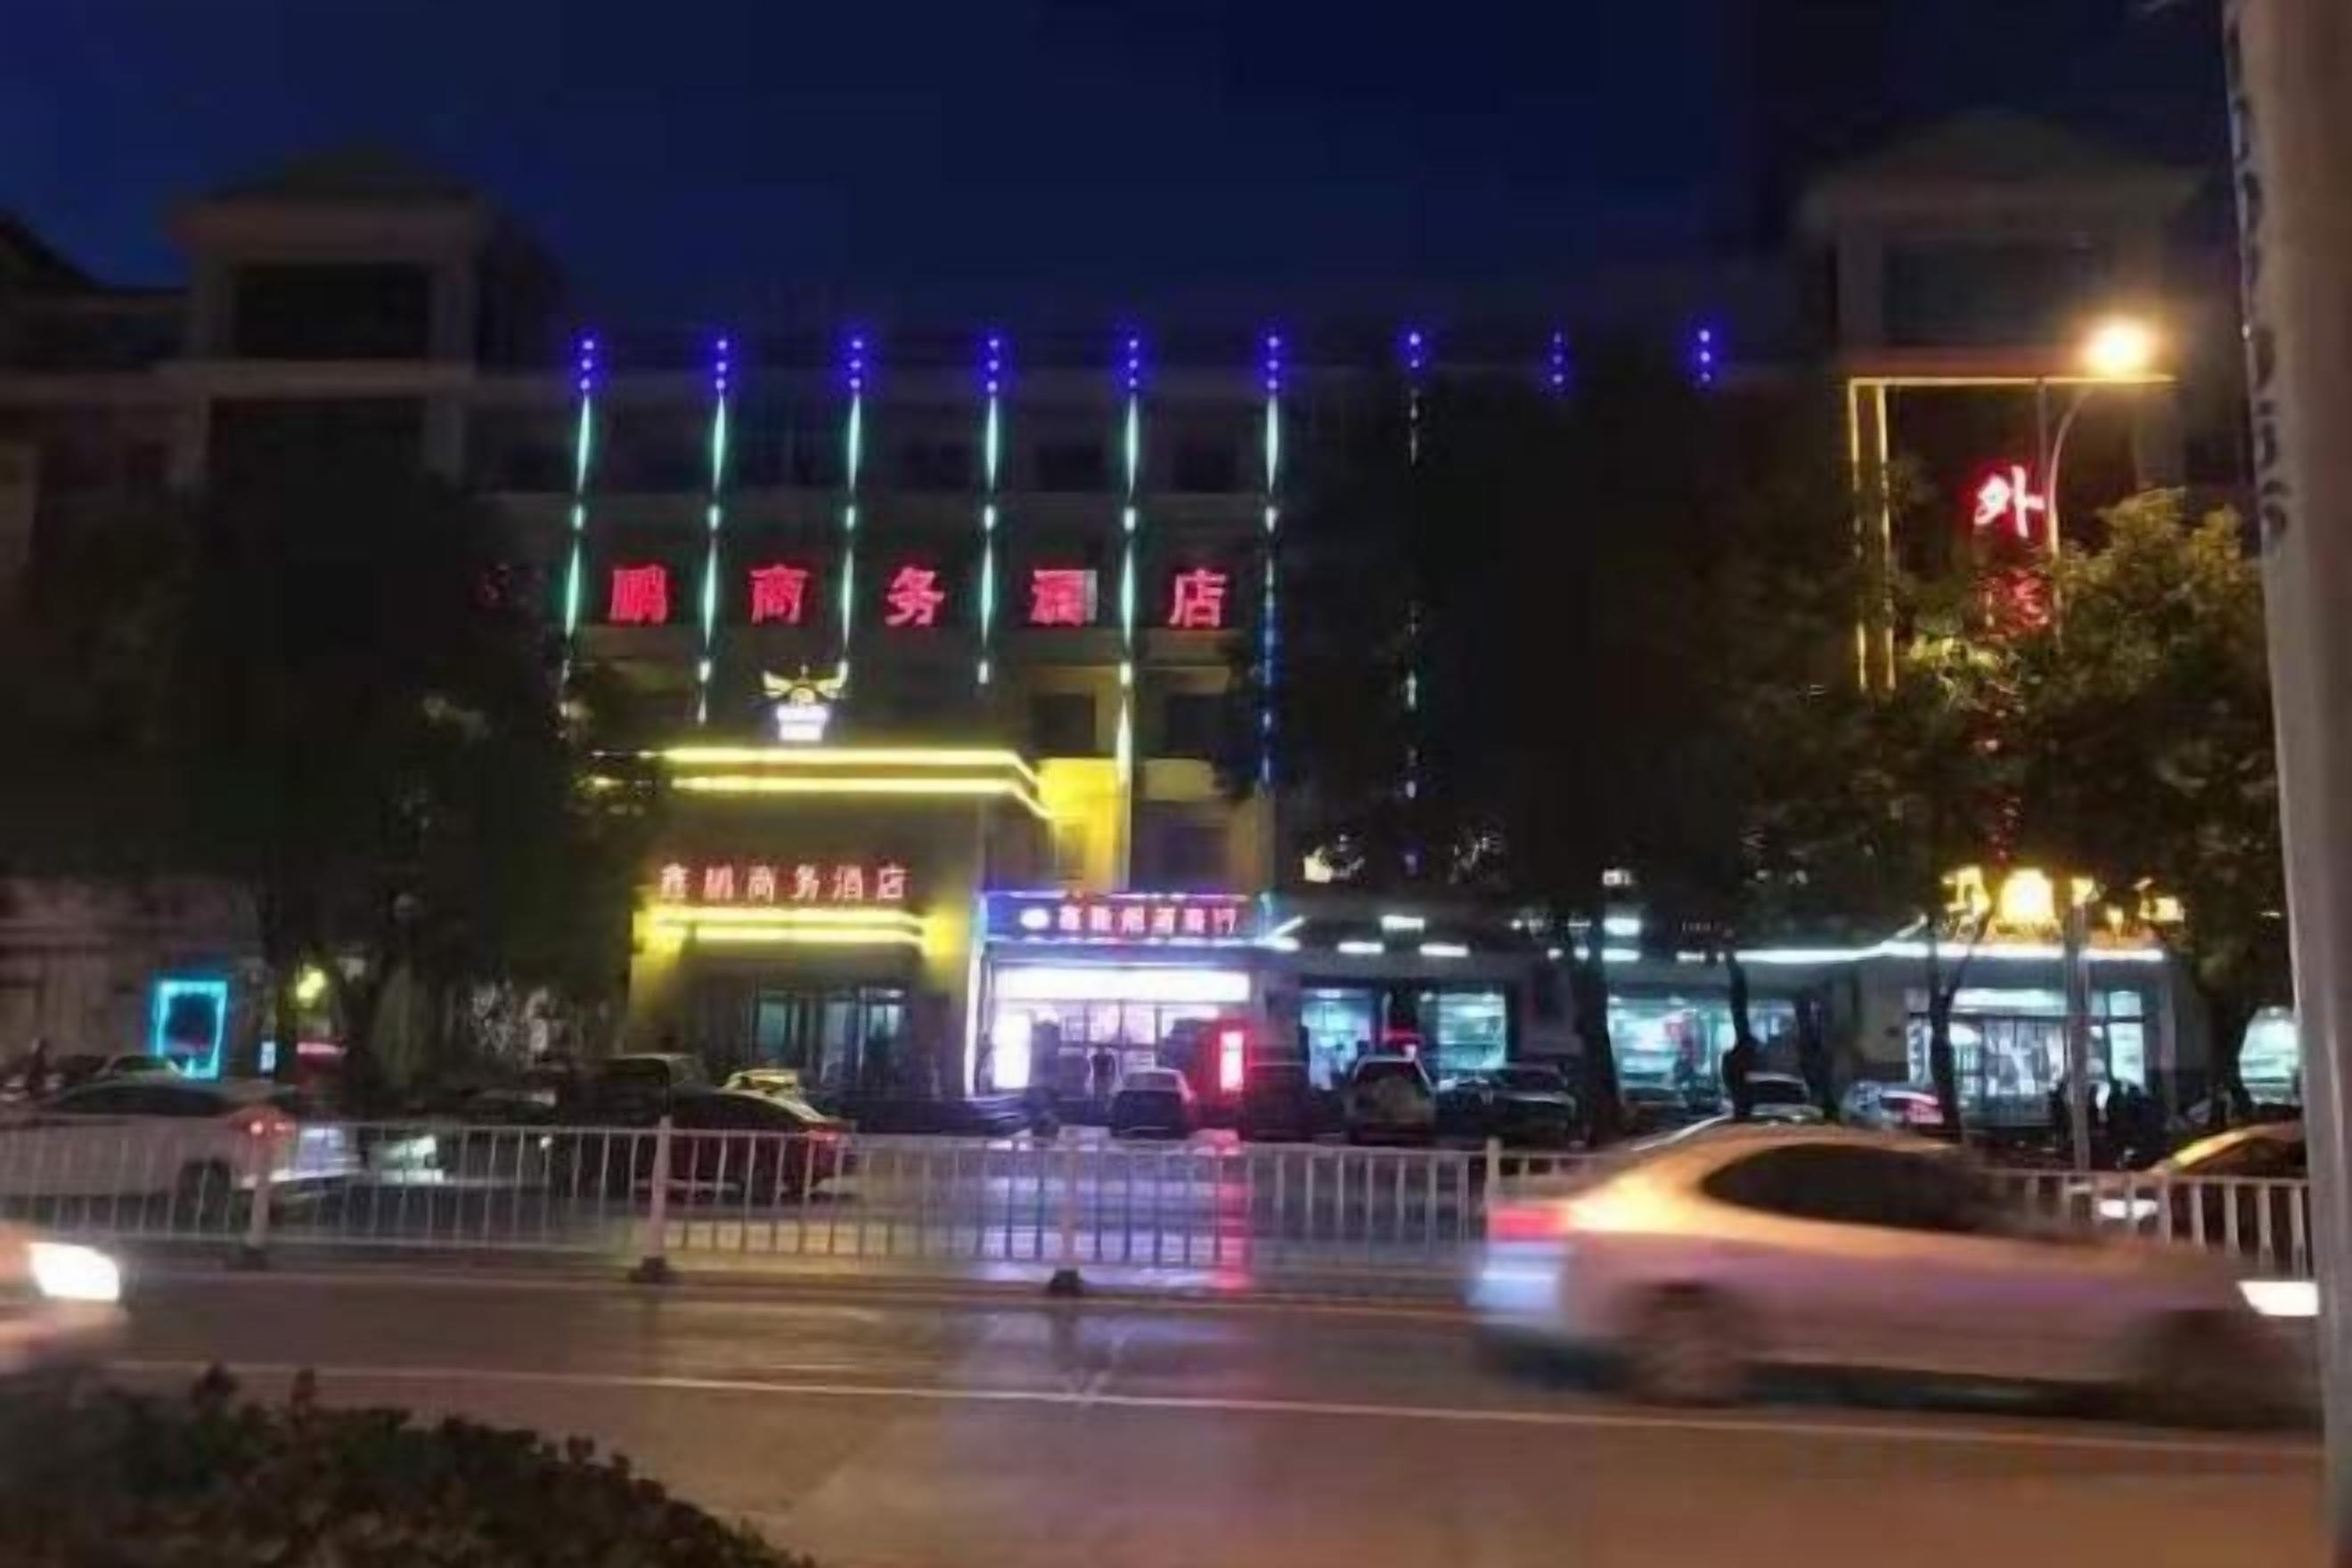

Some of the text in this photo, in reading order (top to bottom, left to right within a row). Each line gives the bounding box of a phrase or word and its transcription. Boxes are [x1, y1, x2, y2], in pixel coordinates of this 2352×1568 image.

[1973, 465, 2046, 539] 外
[481, 563, 1228, 629] 鹏商务酒店
